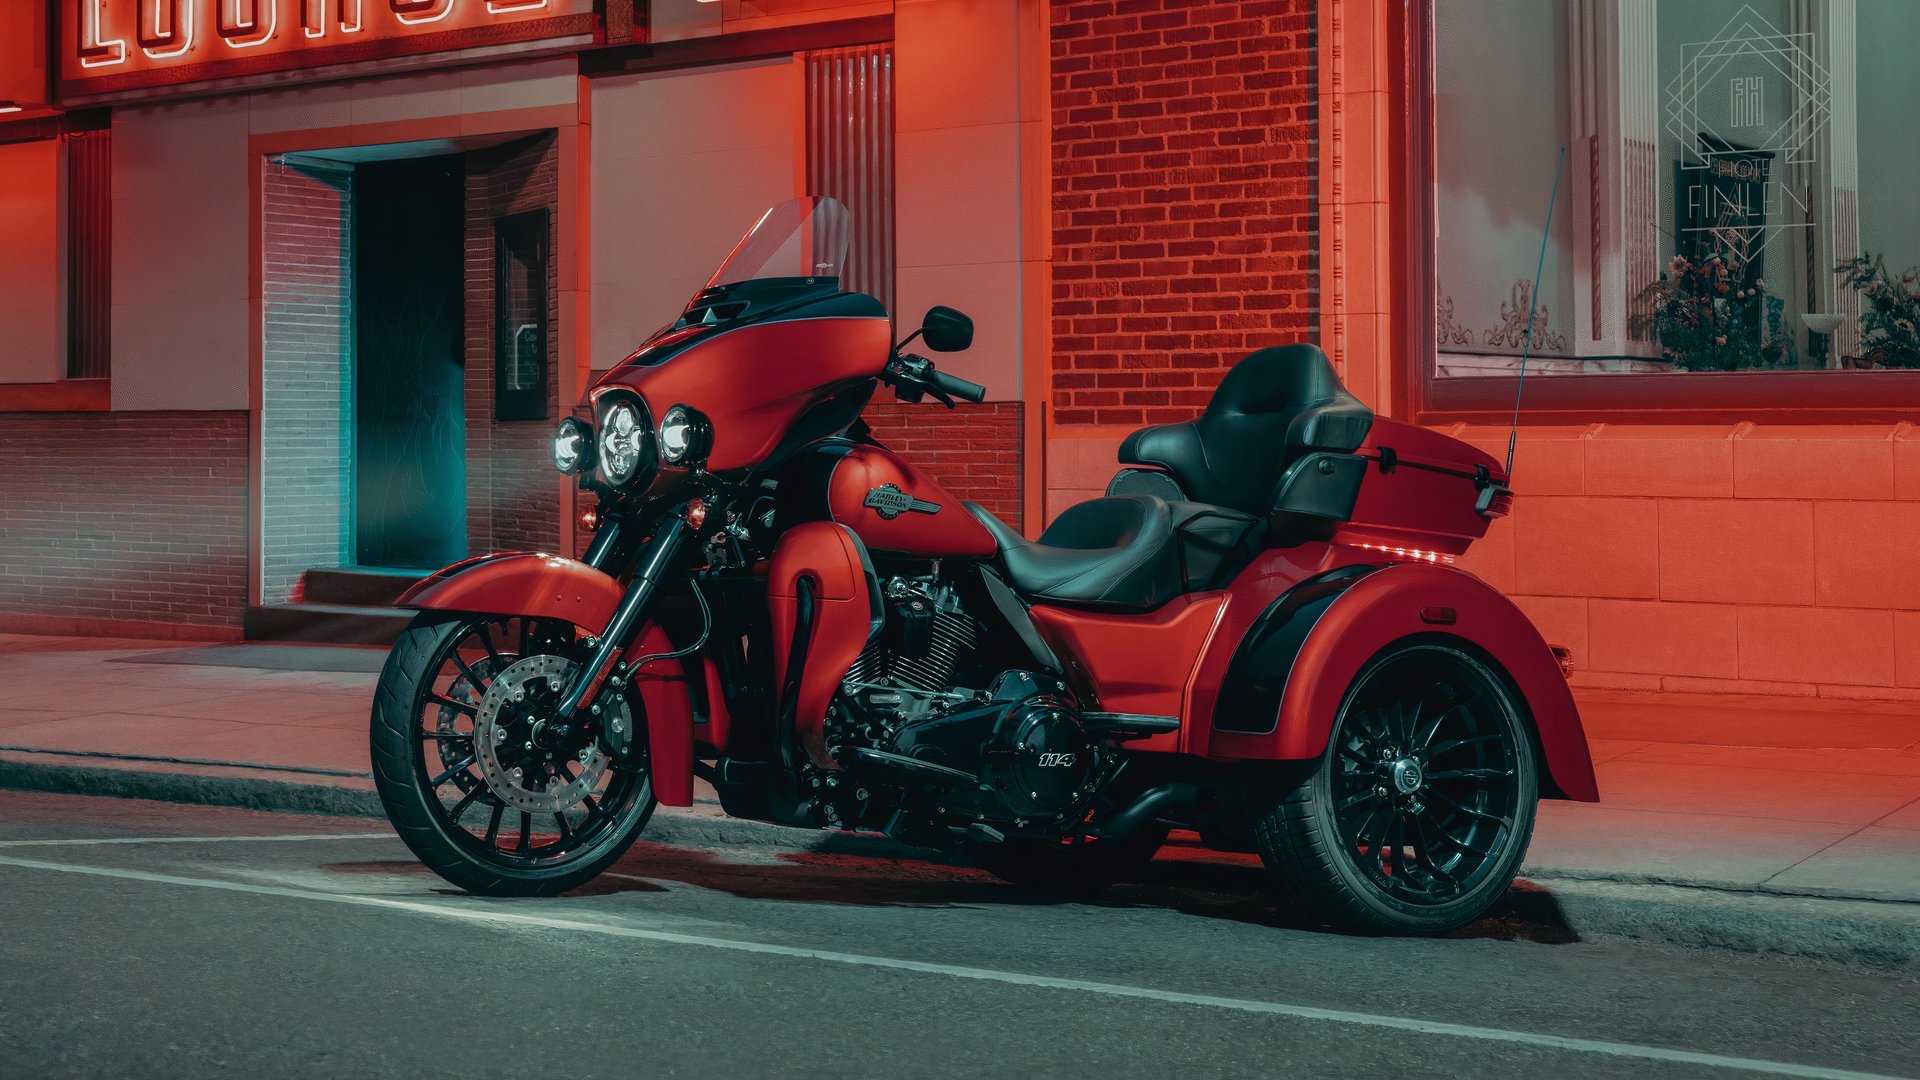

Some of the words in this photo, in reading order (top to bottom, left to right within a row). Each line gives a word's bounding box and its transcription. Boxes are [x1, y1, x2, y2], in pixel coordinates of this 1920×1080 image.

[1718, 157, 1777, 179] HOTEL
[1688, 180, 1808, 219] FINLEN
[1038, 752, 1077, 767] 114
